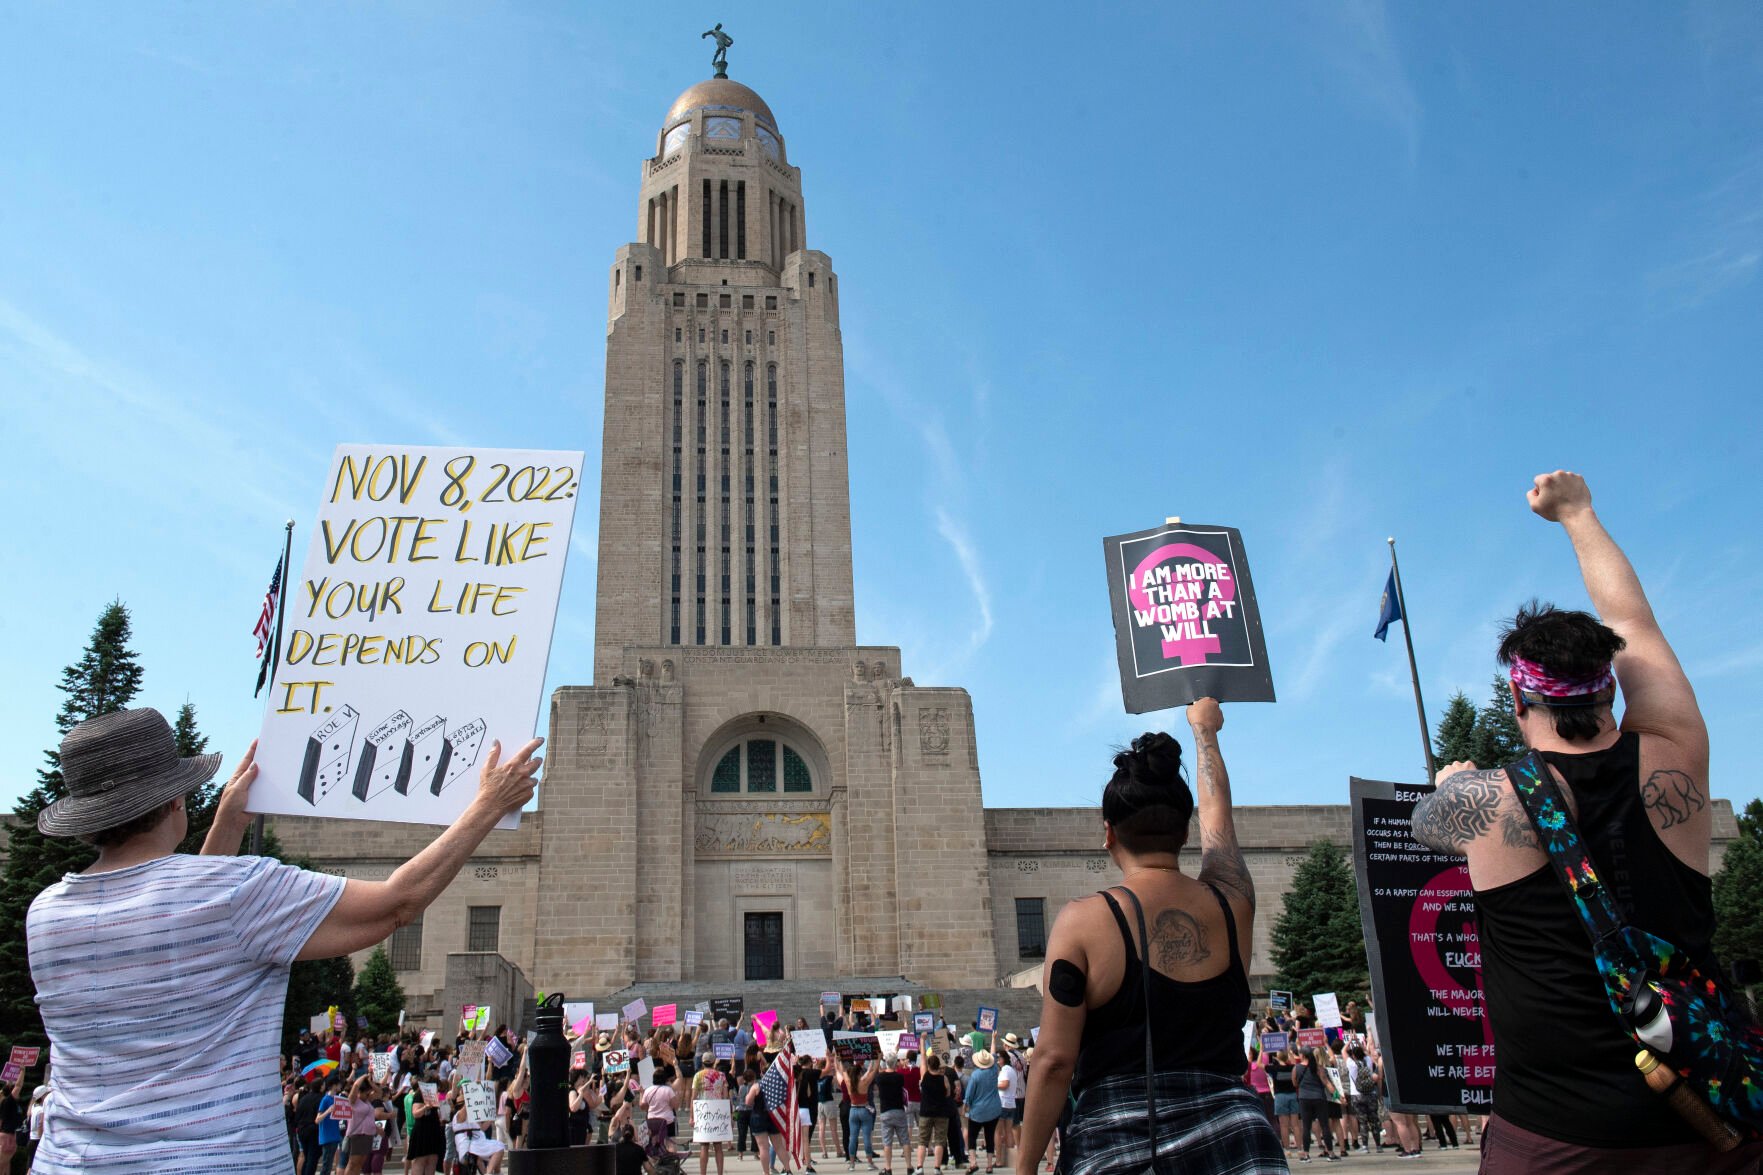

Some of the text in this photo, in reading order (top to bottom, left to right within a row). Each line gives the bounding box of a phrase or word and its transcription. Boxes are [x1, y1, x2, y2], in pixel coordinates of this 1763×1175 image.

[330, 455, 427, 504] NOV
[321, 516, 553, 566] VOTE LIKE
[1129, 563, 1231, 589] I AM MORE
[305, 576, 529, 622] YOUR LIFE
[1142, 581, 1223, 606] THAN A
[1134, 601, 1236, 628] WOMB AT
[1160, 620, 1218, 643] WILL
[285, 629, 517, 668] DEPENDS ON
[276, 681, 335, 715] IT.
[316, 708, 353, 741] ROE V
[1373, 817, 1380, 825] IF
[1388, 818, 1411, 826] HUMAN
[1366, 829, 1391, 837] OCCURS
[1374, 841, 1392, 849] THEN
[1369, 853, 1397, 861] CERTAIN
[1399, 854, 1420, 862] PARTS
[1458, 866, 1468, 874] TO
[1374, 888, 1384, 896] SO
[1385, 888, 1392, 896] A
[1393, 889, 1417, 897] RAPIST
[1419, 889, 1435, 897] CAN
[1422, 902, 1441, 911] AND
[1444, 903, 1457, 911] WE
[1411, 932, 1443, 942] THAT'S
[1446, 933, 1453, 942] A
[1429, 989, 1485, 1001] THE MAJOR
[1427, 1006, 1485, 1017] WILL NEVER
[1436, 1044, 1453, 1056] WE
[1456, 1044, 1478, 1056] THE
[1428, 1065, 1445, 1077] WE
[1448, 1066, 1472, 1078] ARE
